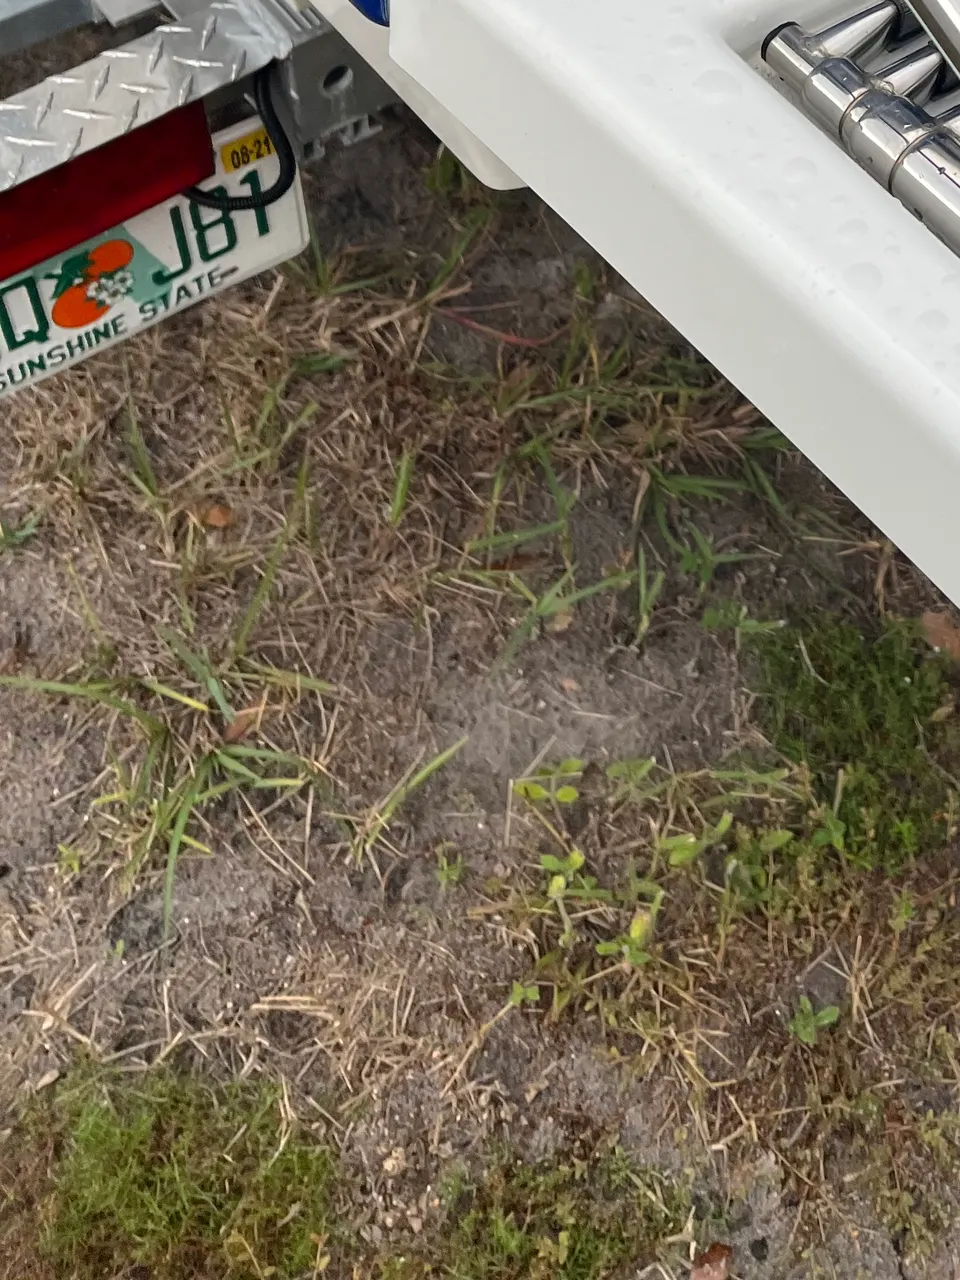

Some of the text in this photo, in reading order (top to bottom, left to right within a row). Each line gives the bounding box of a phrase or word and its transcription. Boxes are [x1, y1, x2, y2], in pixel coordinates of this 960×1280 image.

[231, 136, 272, 169] 08-21
[0, 169, 270, 351] Q JB1
[139, 267, 222, 321] STATE
